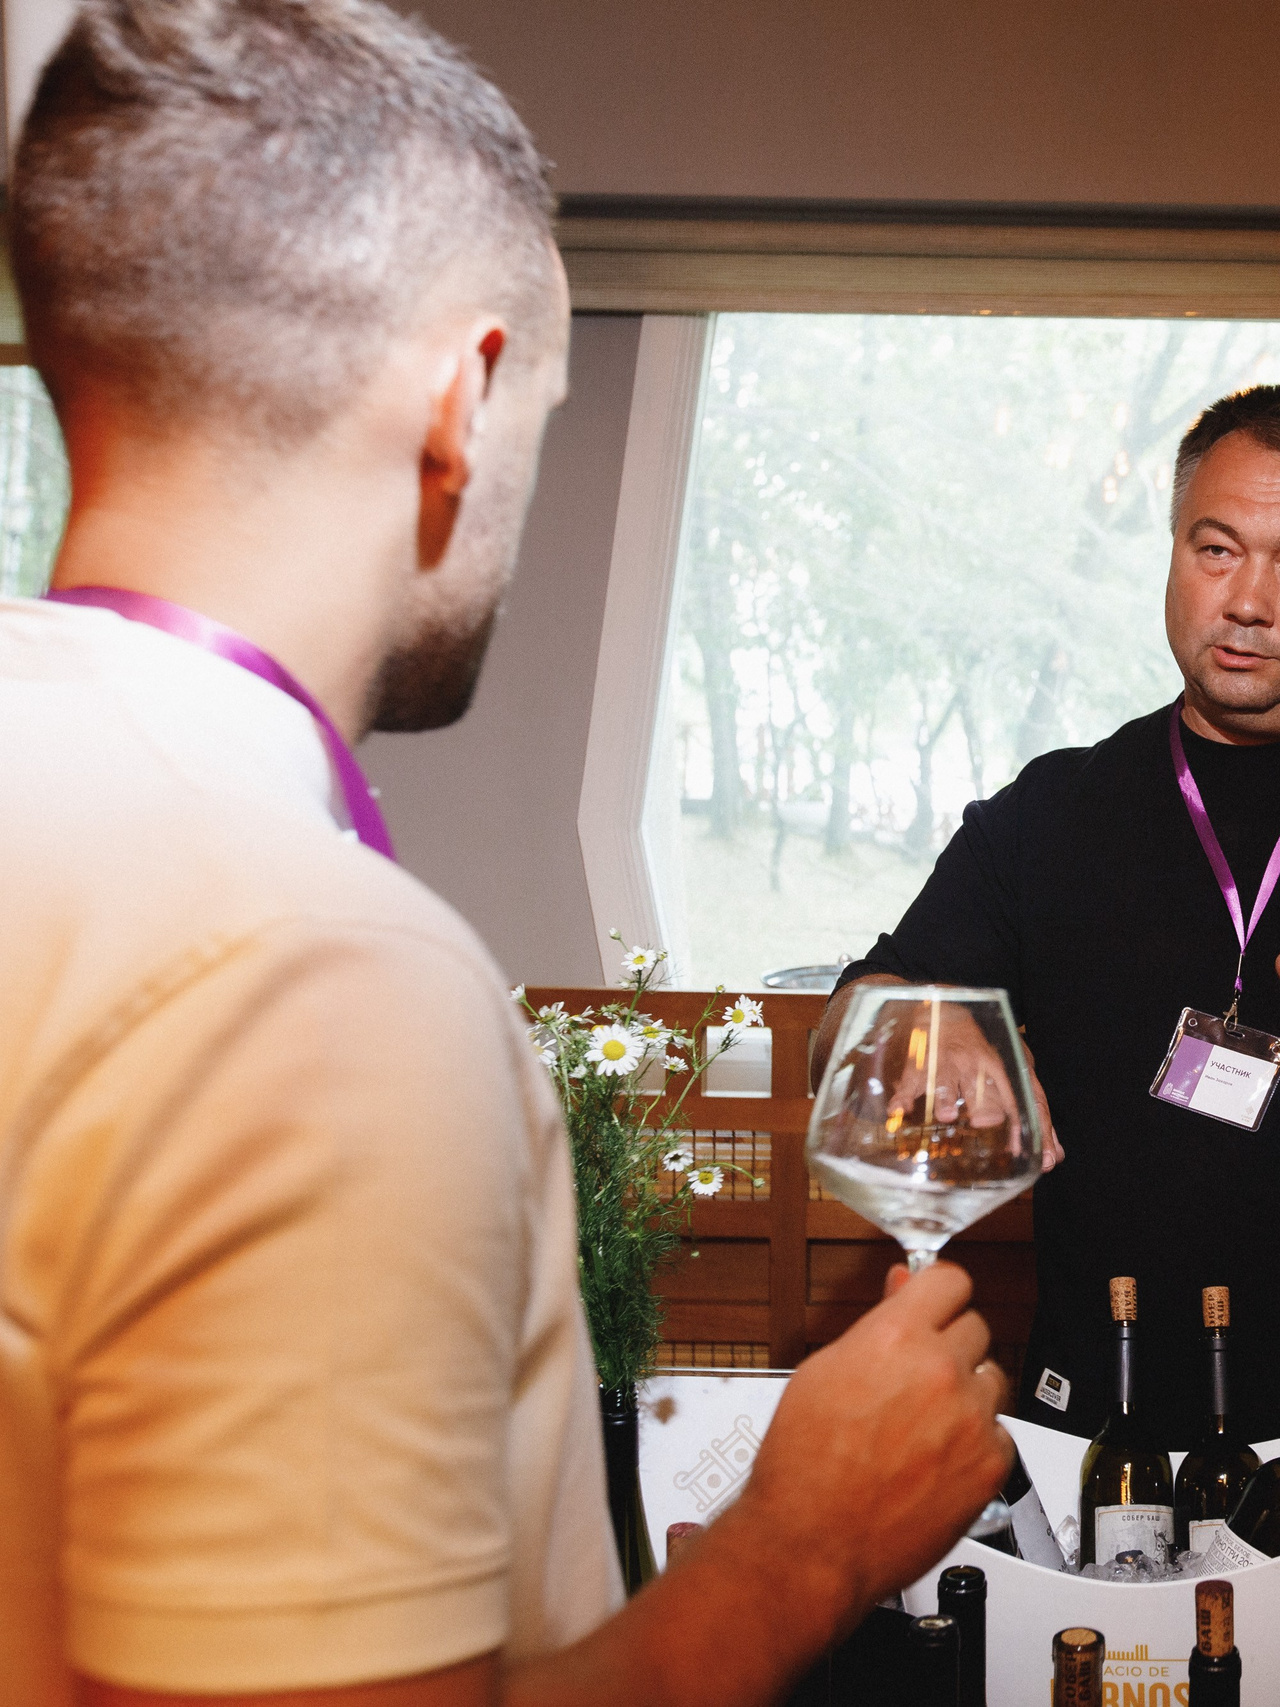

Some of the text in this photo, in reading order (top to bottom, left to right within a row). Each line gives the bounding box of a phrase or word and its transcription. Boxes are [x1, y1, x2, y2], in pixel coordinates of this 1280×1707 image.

[1210, 1060, 1252, 1079] УЧАСТНИК
[1122, 1514, 1160, 1522] СОБЕР БАШ
[1225, 1546, 1239, 1562] ГРИ
[1237, 1556, 1254, 1568] 20
[1201, 1609, 1212, 1652] БАШ
[1103, 1666, 1170, 1677] ACIO DE
